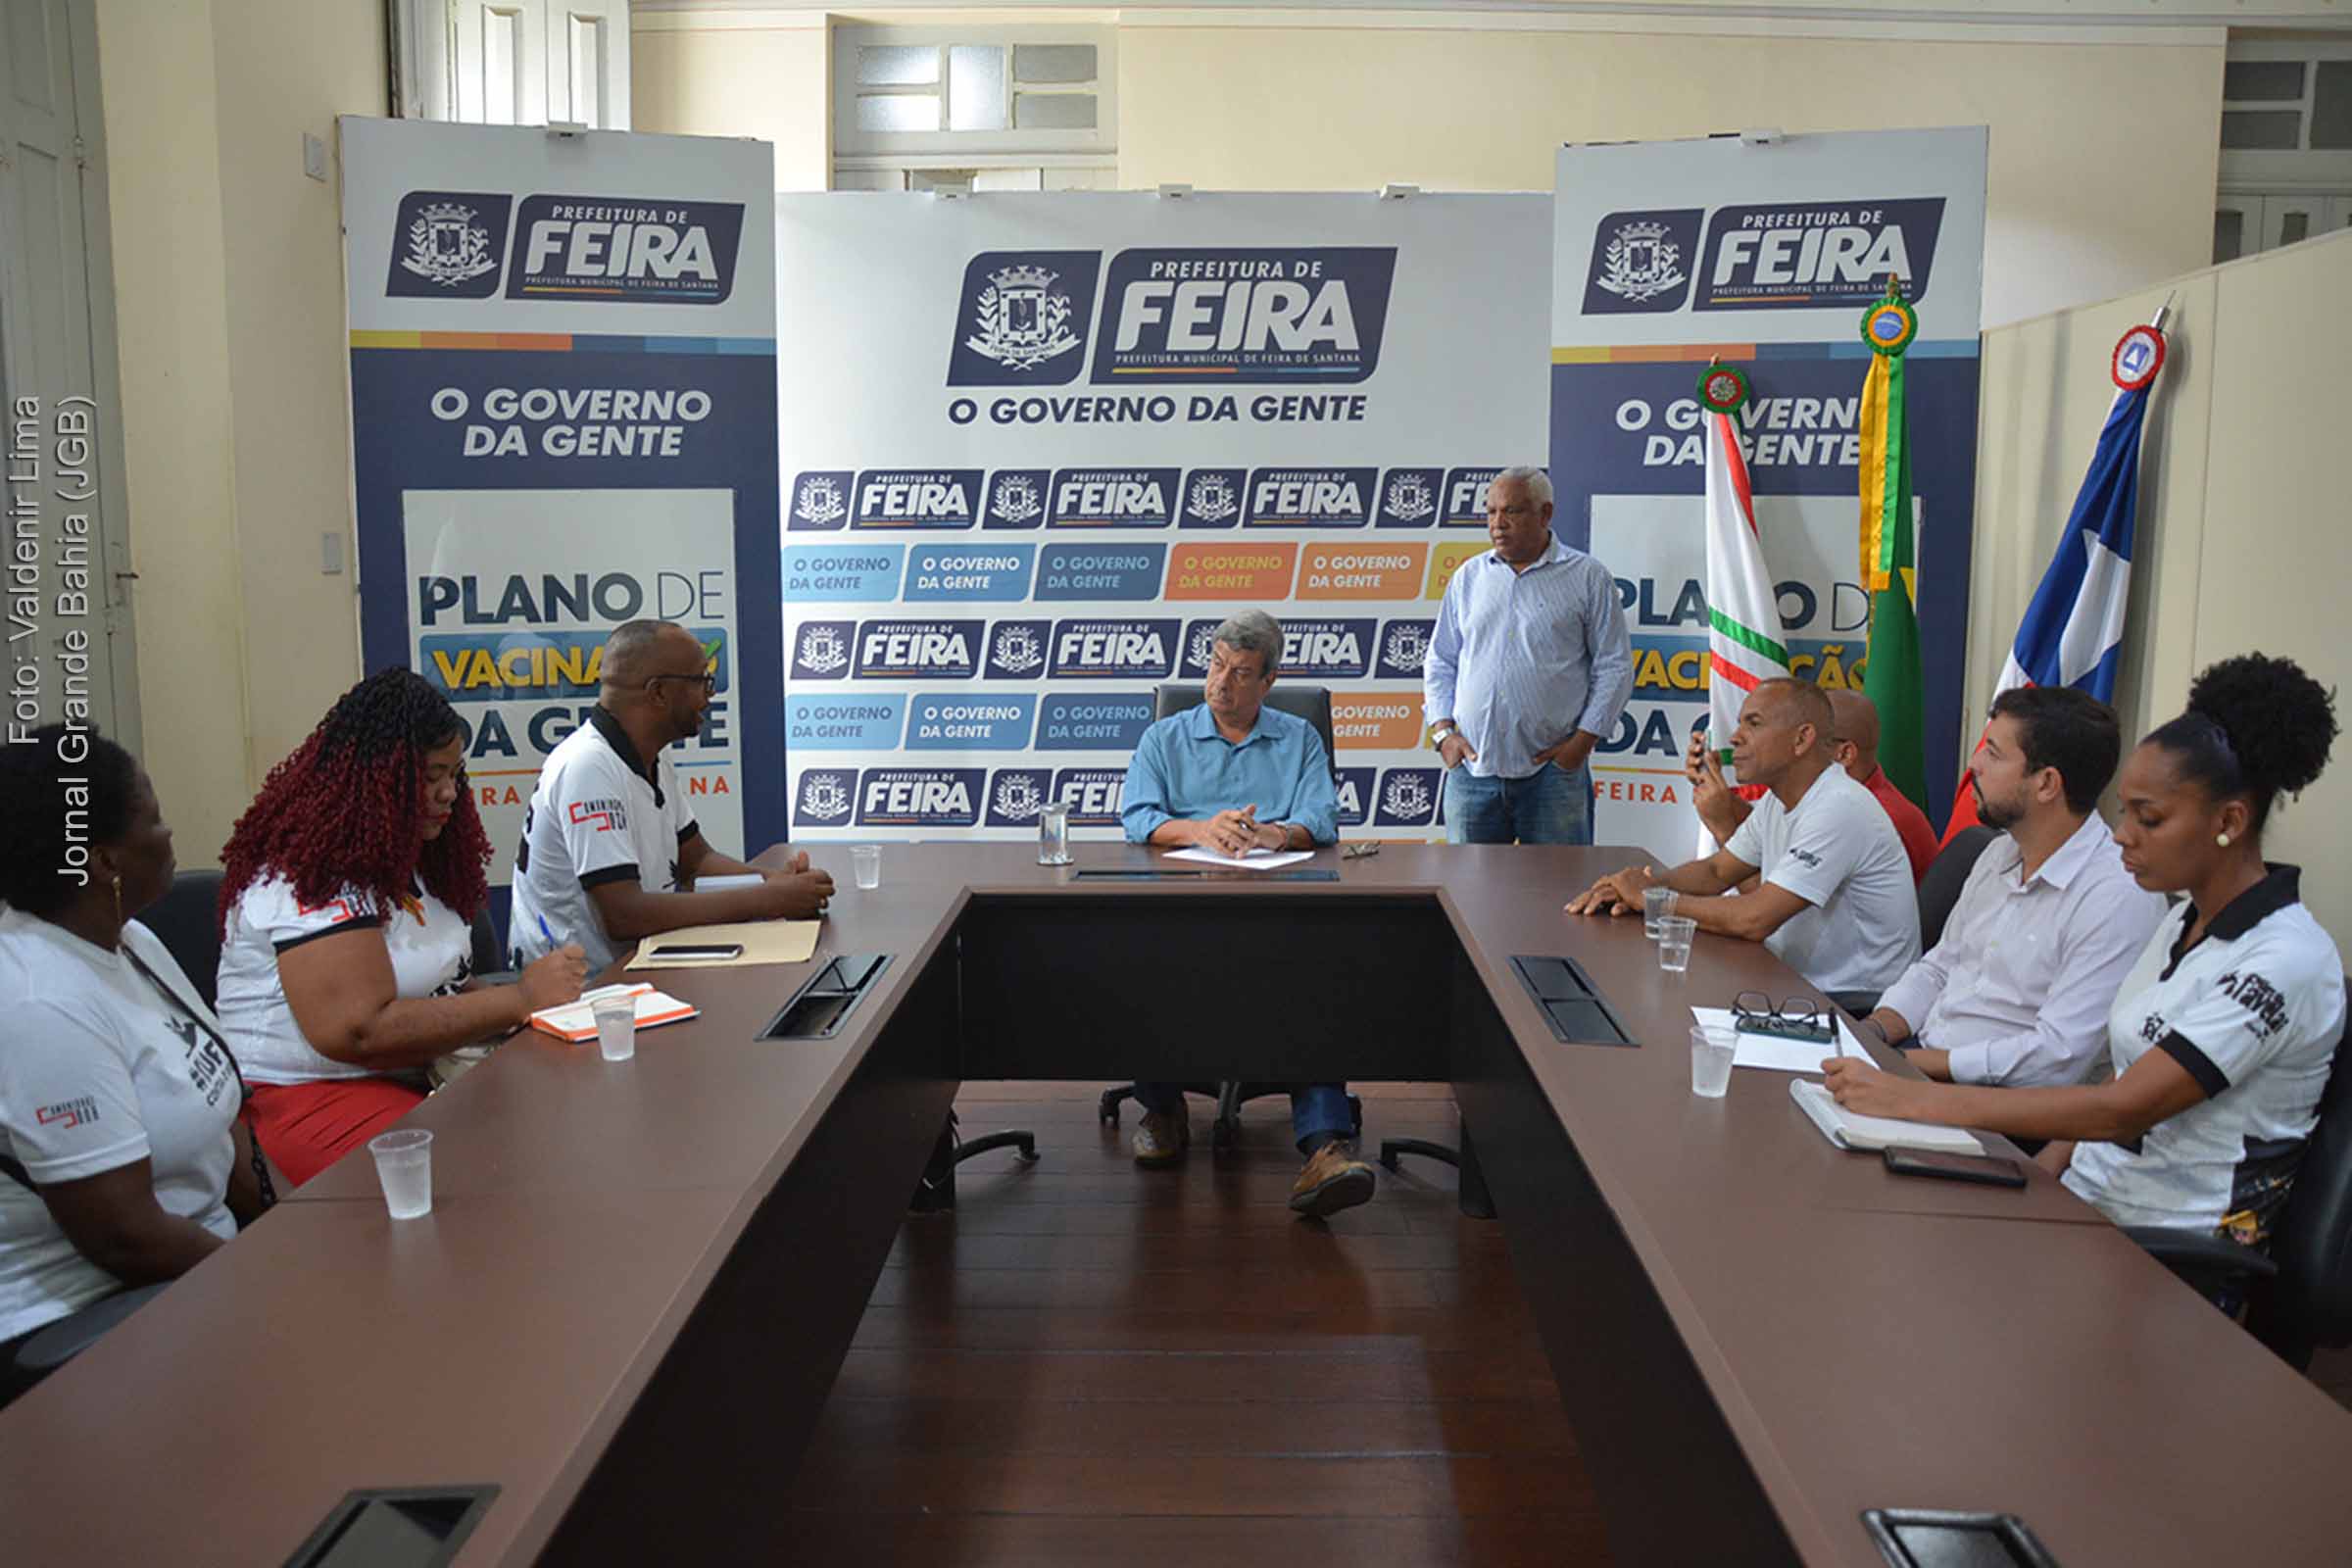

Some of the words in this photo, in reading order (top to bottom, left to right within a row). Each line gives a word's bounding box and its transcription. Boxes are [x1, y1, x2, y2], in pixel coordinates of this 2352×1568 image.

[552, 205, 658, 222] PREFEITURA
[665, 209, 686, 223] DE
[1742, 212, 1850, 228] PREFEITURA
[1859, 210, 1882, 224] DE
[525, 220, 717, 280] FEIRA
[1712, 224, 1912, 285] FEIRA
[1151, 261, 1284, 278] PREFEITURA
[1295, 261, 1322, 277] DE
[1114, 279, 1360, 352] FEIRA
[1115, 355, 1178, 364] PREFEITURA
[1184, 354, 1240, 363] MUNICIPAL
[1245, 354, 1256, 363] DE
[1261, 354, 1292, 363] FEIRA
[1296, 354, 1308, 363] DE
[1313, 354, 1360, 363] SANTANA
[430, 388, 469, 419] O
[484, 388, 712, 420] GOVERNO
[948, 399, 977, 424] O
[989, 396, 1176, 423] GOVERNO
[1187, 397, 1239, 421] DA
[1250, 396, 1366, 421] GENTE
[1615, 400, 1651, 430] O
[1665, 398, 1861, 430] GVERN
[463, 425, 529, 458] DA
[541, 425, 684, 458] GENTE
[1643, 435, 1704, 466] DA
[875, 474, 936, 484] PREFEITURA
[939, 474, 953, 484] DE
[1071, 473, 1132, 483] PREFEITURA
[1135, 473, 1149, 482] DE
[1269, 472, 1329, 481] PREFEITURA
[1332, 472, 1347, 481] DE
[860, 484, 969, 516] FEIRA
[1055, 482, 1166, 515] FEIRA
[1253, 481, 1362, 514] FEIRA
[794, 558, 807, 571] O
[811, 557, 891, 571] GOVERNO
[922, 558, 936, 571] O
[940, 557, 1019, 571] GOVERNO
[1053, 557, 1066, 570] O
[1069, 556, 1150, 570] GOVERNO
[1184, 556, 1198, 570] O
[1201, 556, 1282, 570] GOVERNO
[1314, 556, 1328, 570] O
[1331, 556, 1411, 570] GOVERNO
[789, 576, 809, 590] DA
[814, 576, 860, 590] GENTE
[917, 575, 939, 589] DA
[944, 575, 991, 589] GENTE
[1047, 575, 1068, 589] DA
[1073, 574, 1121, 588] GENTE
[1178, 575, 1200, 588] DA
[1205, 575, 1254, 588] GENTE
[1308, 574, 1330, 588] DA
[1334, 574, 1382, 588] GENTE
[418, 572, 643, 626] PLANO
[658, 571, 724, 619] DE
[877, 624, 937, 634] PREFEITURA
[940, 624, 954, 634] DE
[1072, 623, 1133, 633] PREFEITURA
[1135, 623, 1150, 633] DE
[1332, 623, 1345, 632] DE
[861, 633, 971, 666] FEIRA
[1056, 632, 1166, 665] FEIRA
[1280, 632, 1361, 664] EIRA
[796, 707, 808, 720] O
[812, 707, 892, 720] GOVERNO
[925, 707, 938, 720] O
[942, 707, 1021, 720] GOVERNO
[1054, 707, 1066, 720] O
[1070, 706, 1151, 720] GOVERNO
[1331, 706, 1411, 719] GOVERNO
[792, 725, 811, 738] DA
[815, 725, 863, 738] GENTE
[919, 725, 941, 738] DA
[945, 725, 992, 738] GENTE
[1048, 724, 1069, 738] DA
[1074, 724, 1121, 738] GENTE
[1334, 724, 1381, 737] GENTE
[879, 772, 939, 782] PREFEITURA
[942, 772, 956, 782] DE
[864, 781, 972, 814] FEIRA
[1593, 780, 1679, 805] FEIRA
